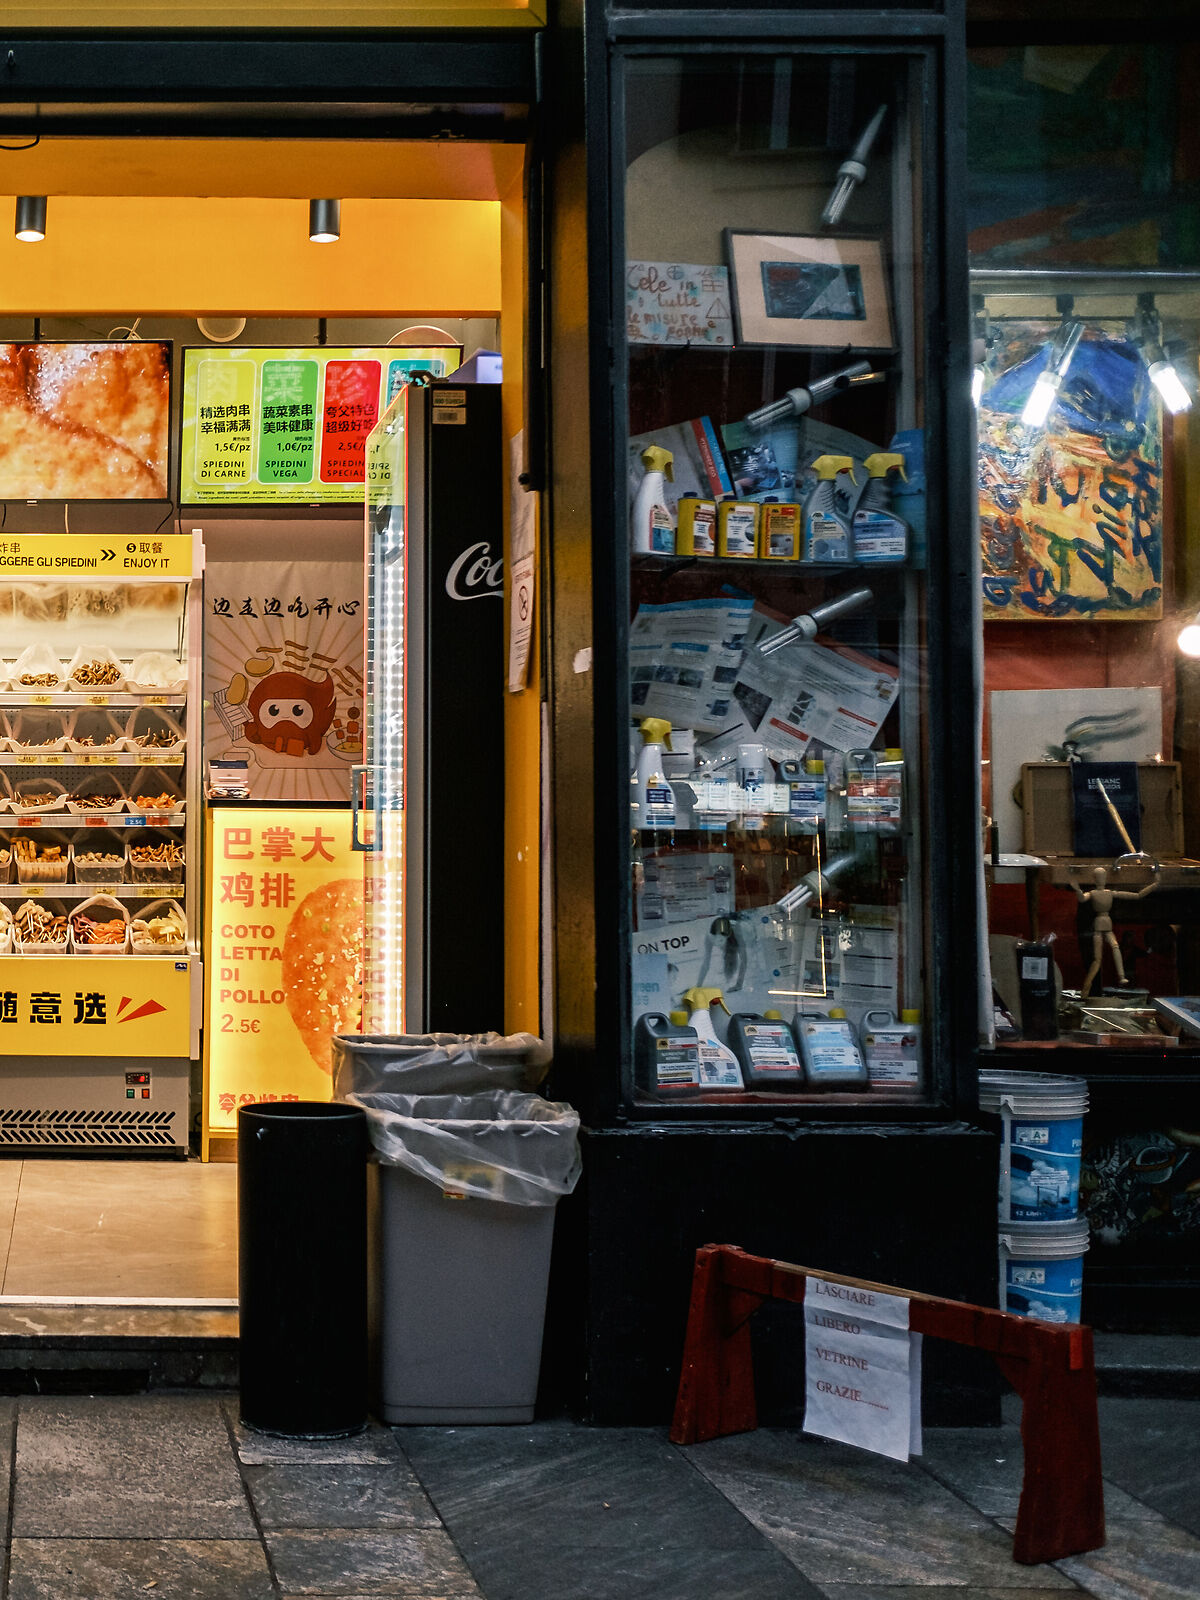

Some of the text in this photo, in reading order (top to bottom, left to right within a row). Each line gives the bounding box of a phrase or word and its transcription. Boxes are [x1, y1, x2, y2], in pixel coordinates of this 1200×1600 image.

[200, 404, 250, 419] 精选肉串
[263, 404, 313, 419] 蔬菜素串
[326, 404, 375, 418] 夸父特色
[200, 419, 251, 434] 幸福满满
[263, 419, 313, 434] 美味健康
[326, 420, 374, 433] 超级好吃
[215, 443, 251, 453] 1,5€/pz
[277, 443, 313, 453] 1,0€/pz
[338, 442, 365, 452] 2,5€/
[139, 542, 163, 554] 取餐
[36, 557, 53, 567] GLI
[55, 557, 97, 568] SPIEDINI
[124, 558, 170, 568] ENJOY IT
[223, 826, 335, 863] 巴掌大
[220, 872, 296, 908] 鸡排
[220, 924, 275, 938] COTO
[661, 936, 690, 951] TOP
[220, 946, 283, 960] LETTA
[220, 968, 239, 981] DI
[220, 989, 285, 1004] POLLO
[220, 1014, 261, 1033] 2.5€
[816, 1283, 875, 1306] LASCIARE
[815, 1316, 860, 1334] LIBERO
[816, 1347, 868, 1370] VETRINE
